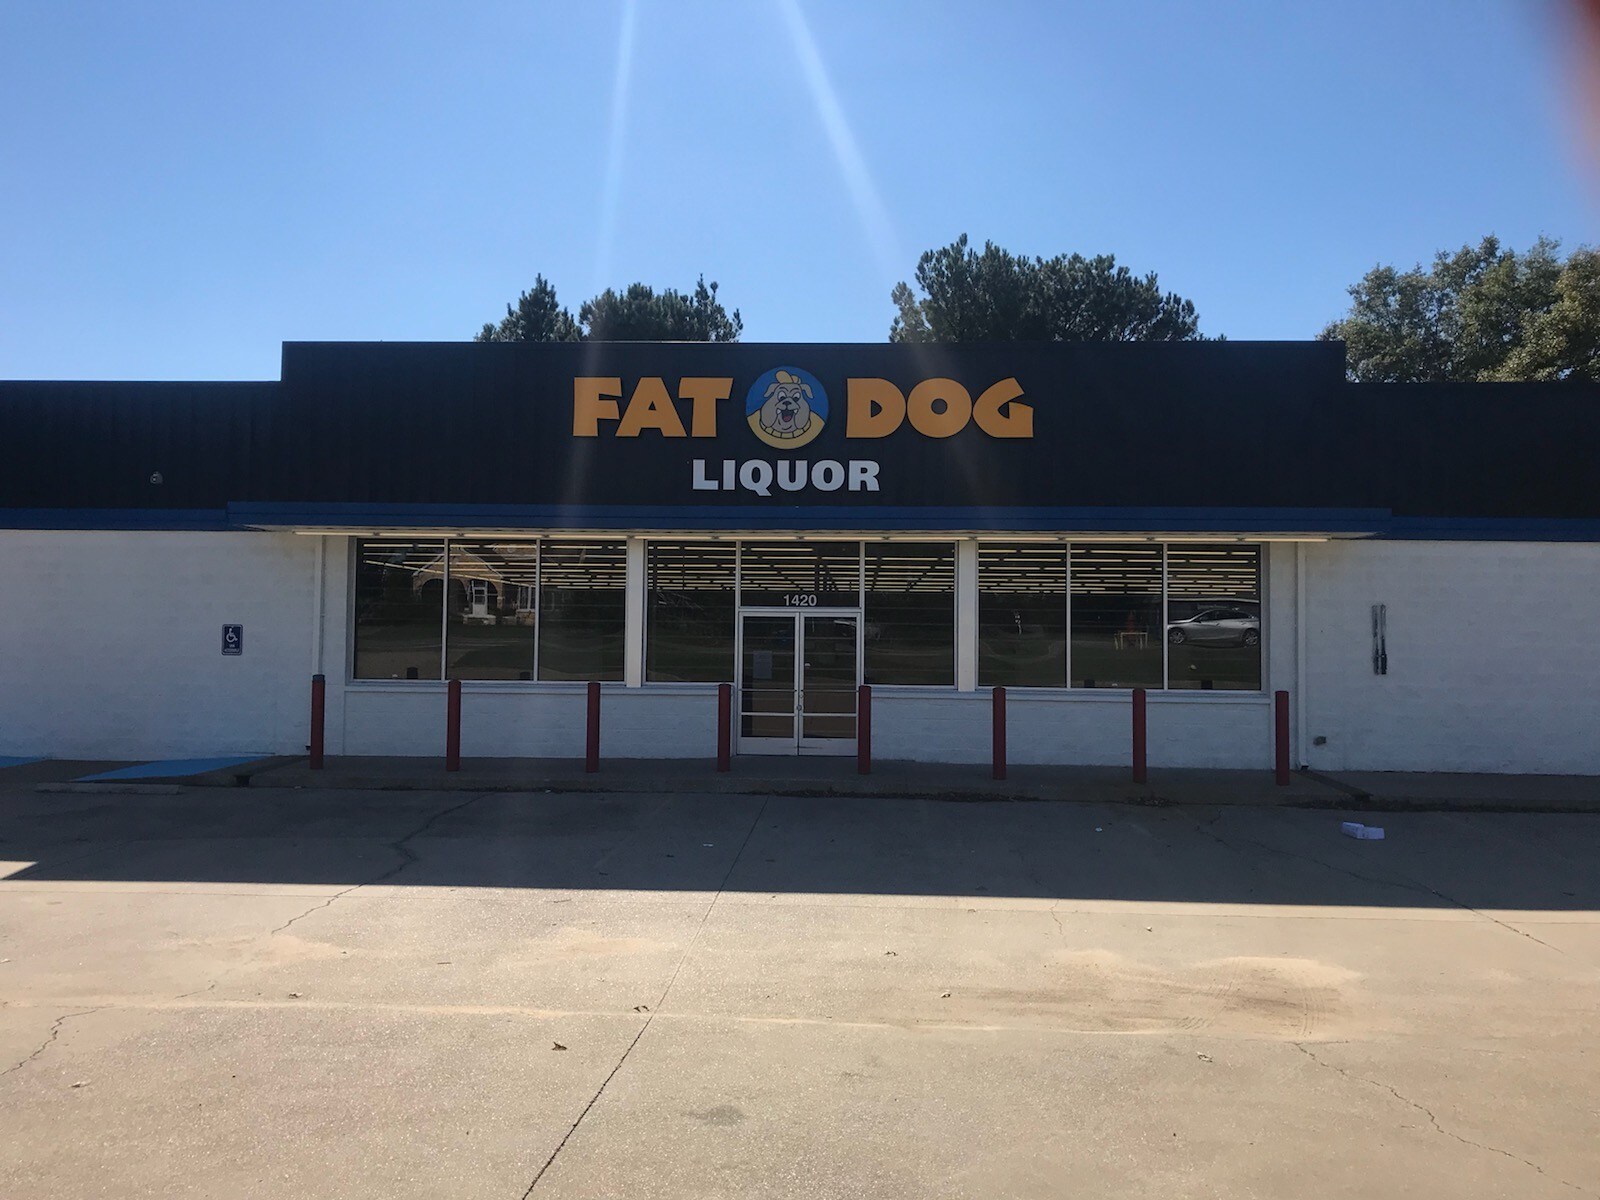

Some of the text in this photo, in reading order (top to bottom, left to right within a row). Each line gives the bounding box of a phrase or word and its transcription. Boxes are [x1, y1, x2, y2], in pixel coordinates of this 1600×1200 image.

[572, 377, 1034, 439] FAT DOG
[692, 459, 880, 496] LIQUOR
[783, 594, 818, 607] 1420
